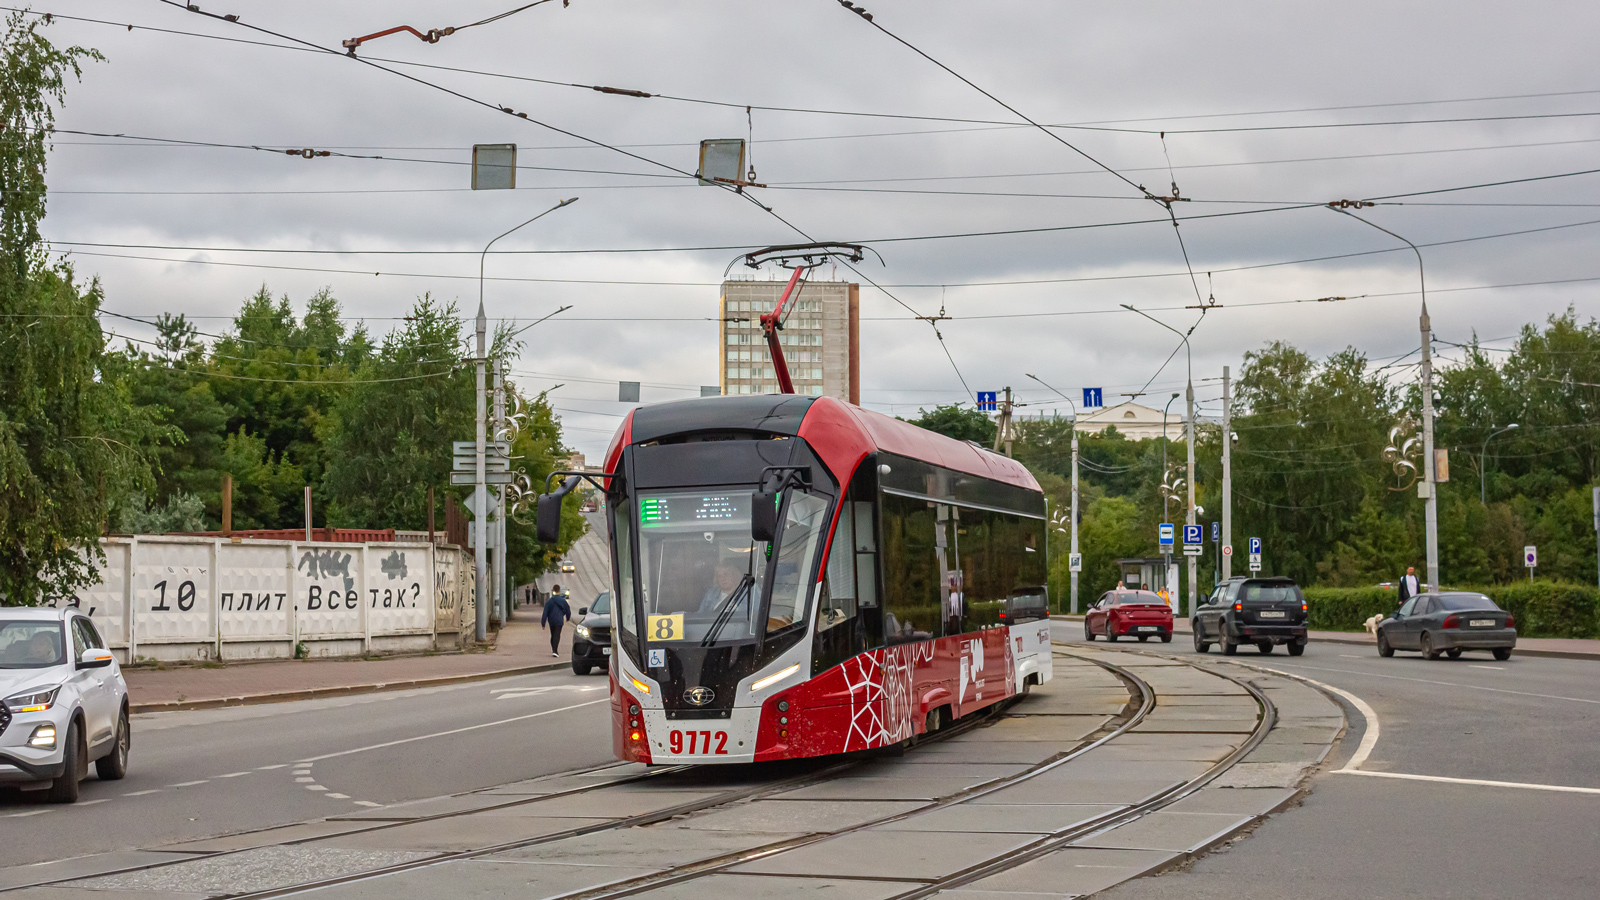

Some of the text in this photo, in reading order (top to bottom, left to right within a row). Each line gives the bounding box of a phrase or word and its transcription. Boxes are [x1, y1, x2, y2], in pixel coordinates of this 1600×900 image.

[151, 580, 196, 612] 10
[369, 582, 421, 608] так?
[655, 617, 674, 640] 8
[669, 729, 729, 755] 9772
